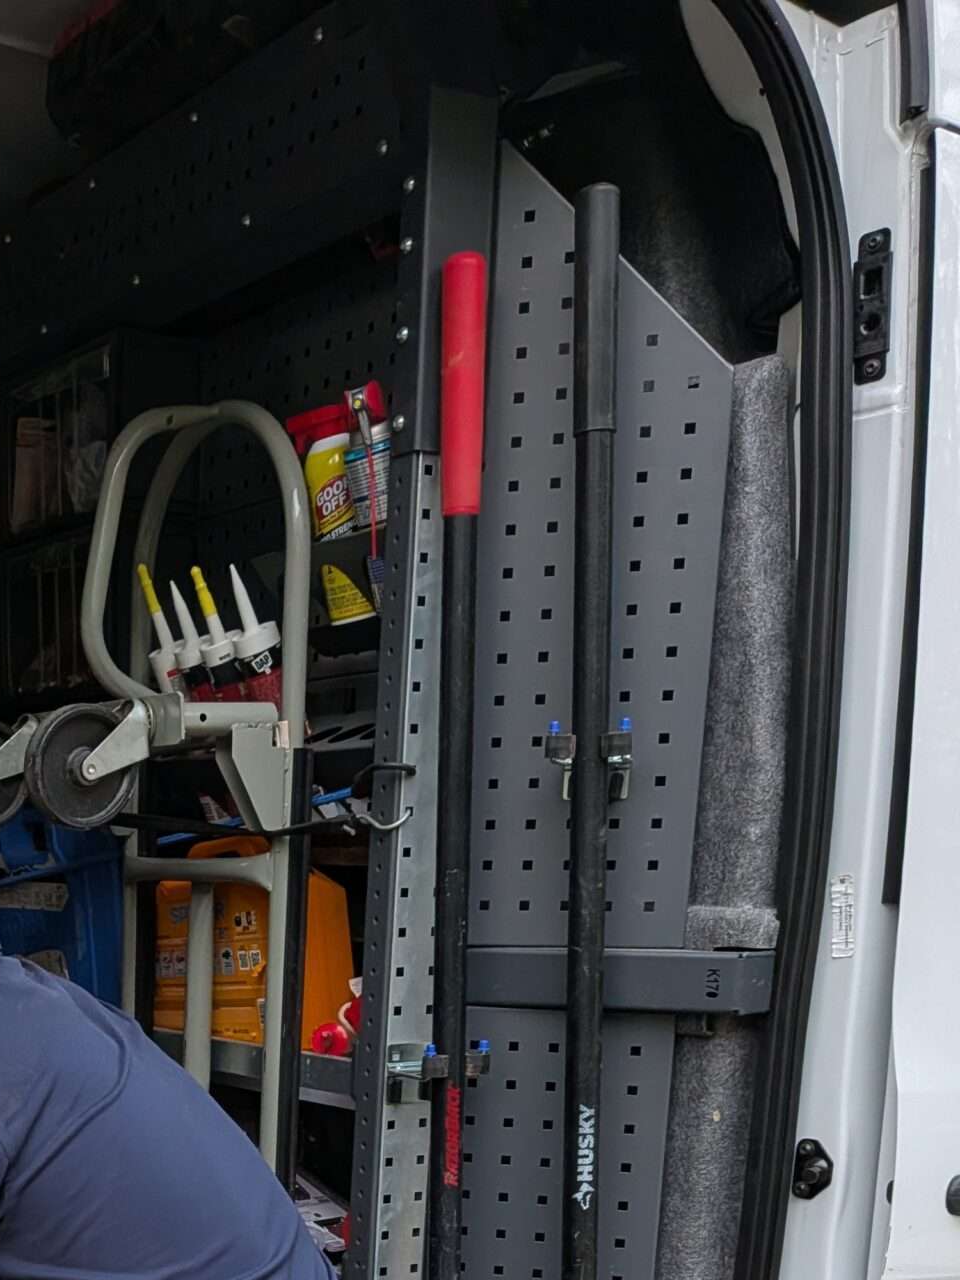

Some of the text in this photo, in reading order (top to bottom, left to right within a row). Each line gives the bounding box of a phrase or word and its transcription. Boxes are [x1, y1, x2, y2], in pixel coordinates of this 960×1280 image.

[321, 490, 347, 516] OFF
[254, 654, 271, 670] DAP
[576, 1104, 596, 1182] HUSKY
